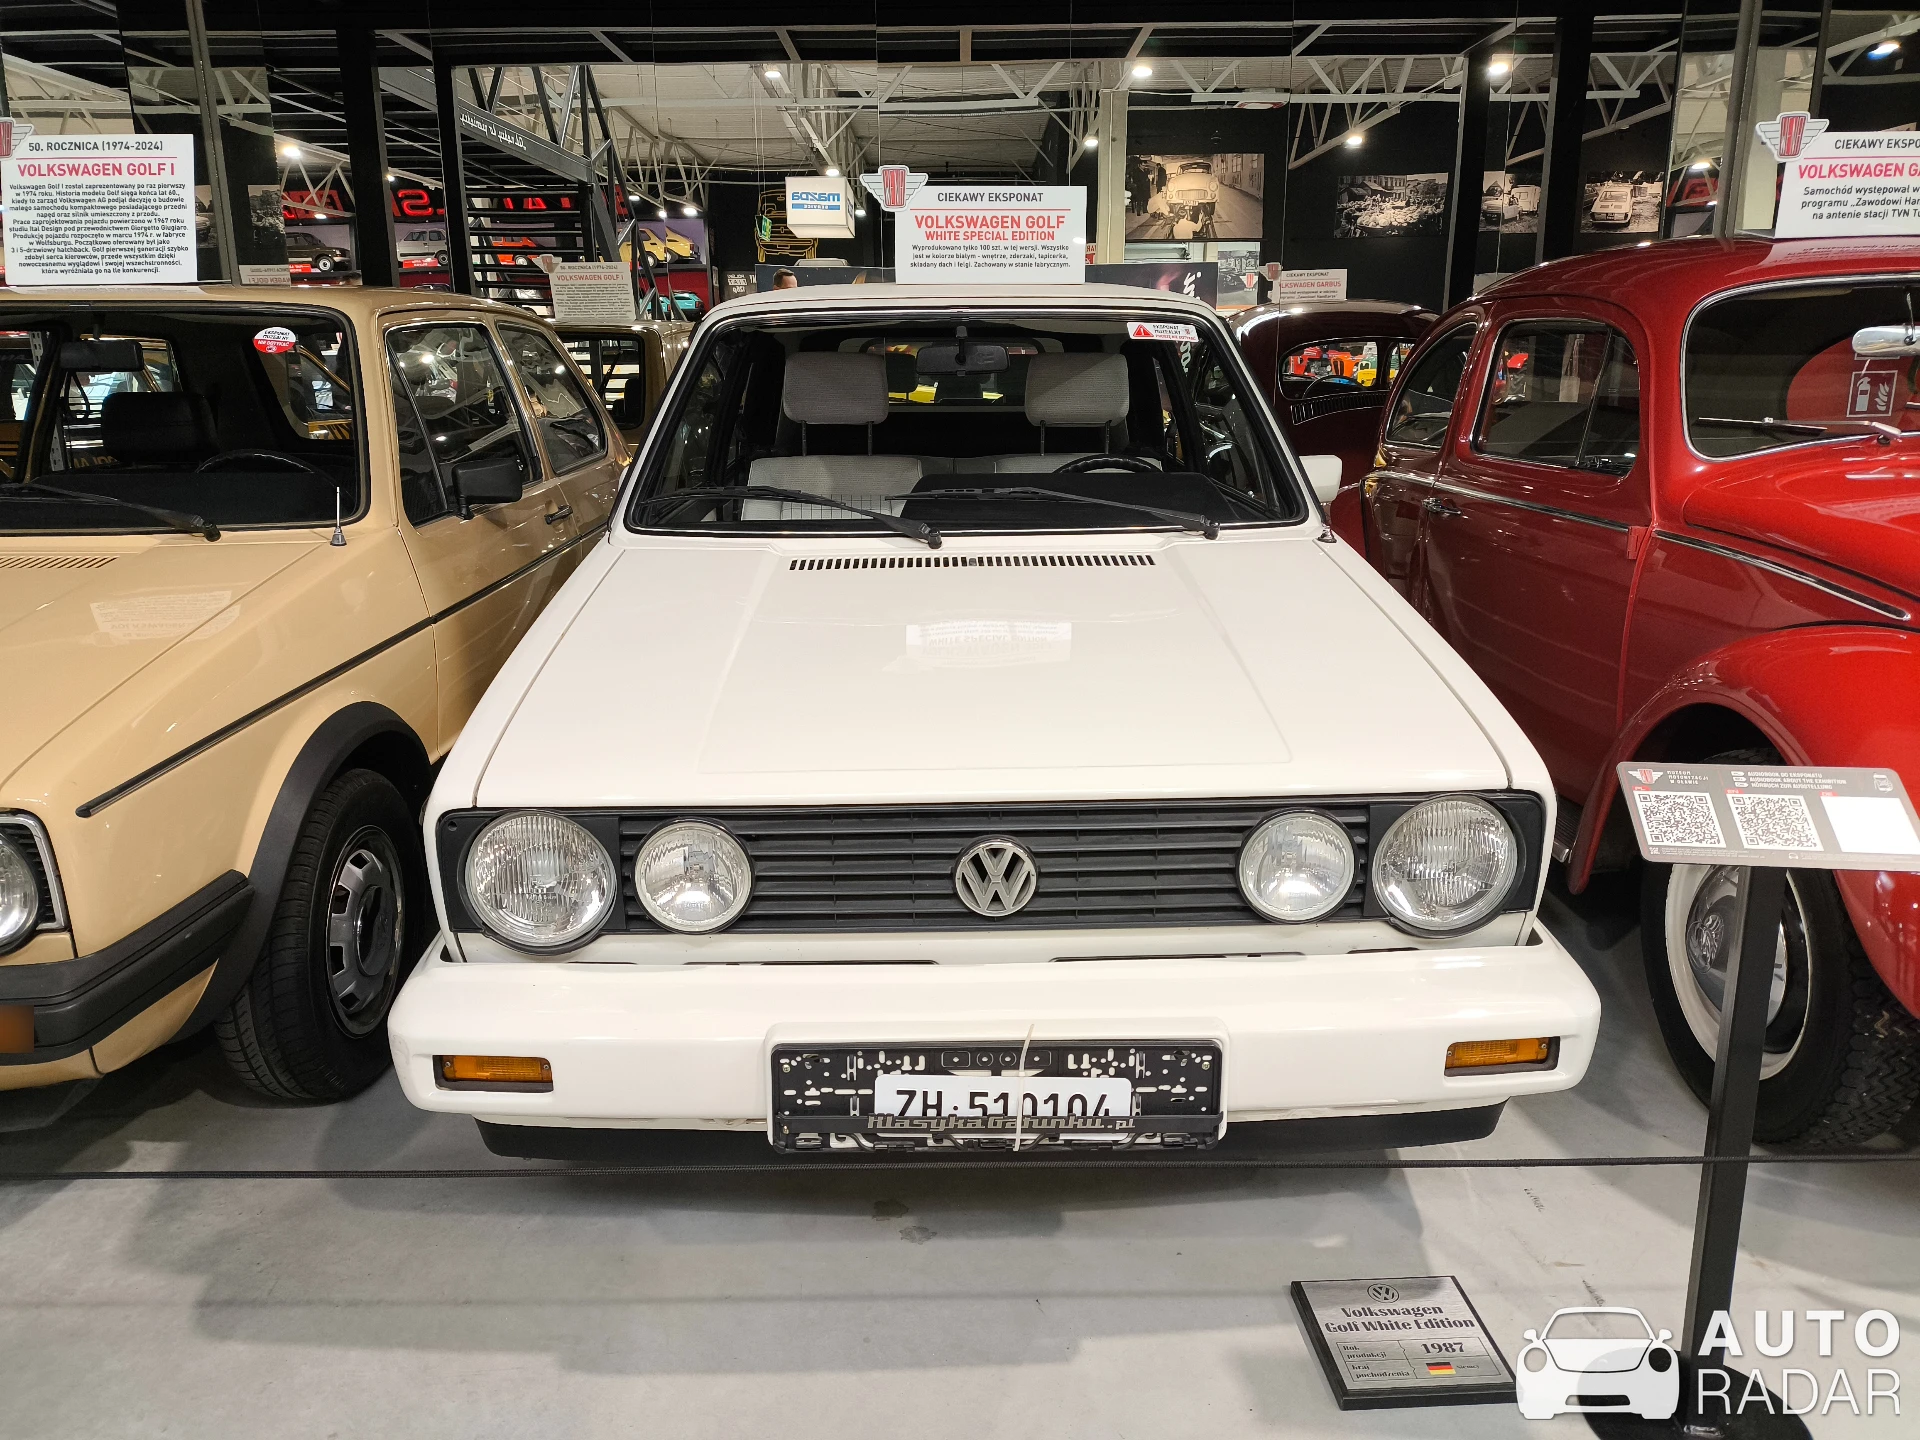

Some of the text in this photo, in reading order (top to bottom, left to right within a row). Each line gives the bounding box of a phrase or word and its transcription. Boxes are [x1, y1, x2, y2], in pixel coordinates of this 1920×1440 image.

[28, 141, 163, 151] 50. ROCZNICA (1974-2024)
[1834, 139, 1884, 149] CIEKAWY
[18, 163, 175, 177] VOLKSWAGEN GOLF I
[1798, 163, 1905, 179] VOLKSWAGEN
[1803, 185, 1853, 196] Samochód
[1855, 185, 1910, 196] występował
[36, 197, 58, 205] zarząd
[937, 192, 1044, 202] CIEKAWY EKSPONAT
[1801, 200, 1848, 210] programu
[1812, 212, 1824, 220] na
[1826, 211, 1861, 219] antenie
[1864, 209, 1889, 220] stacji
[1891, 208, 1910, 218] TVN
[32, 218, 83, 226] zaprojektowania
[914, 215, 1066, 229] VOLKSWAGEN GOLF
[162, 231, 186, 239] fabryce
[925, 230, 1055, 241] WHITE SPECIAL EDITION
[74, 239, 111, 247] Początkowo
[1019, 244, 1040, 252] wersji.
[157, 252, 176, 260] dzięki
[955, 252, 977, 260] białym
[1038, 252, 1068, 260] tapicerka,
[1034, 261, 1071, 269] fabrycznym.
[1317, 280, 1342, 288] GARBUS
[1341, 1305, 1444, 1318] Volkswagen
[1325, 1317, 1476, 1334] Golf White Edition
[1420, 1342, 1466, 1355] 1987
